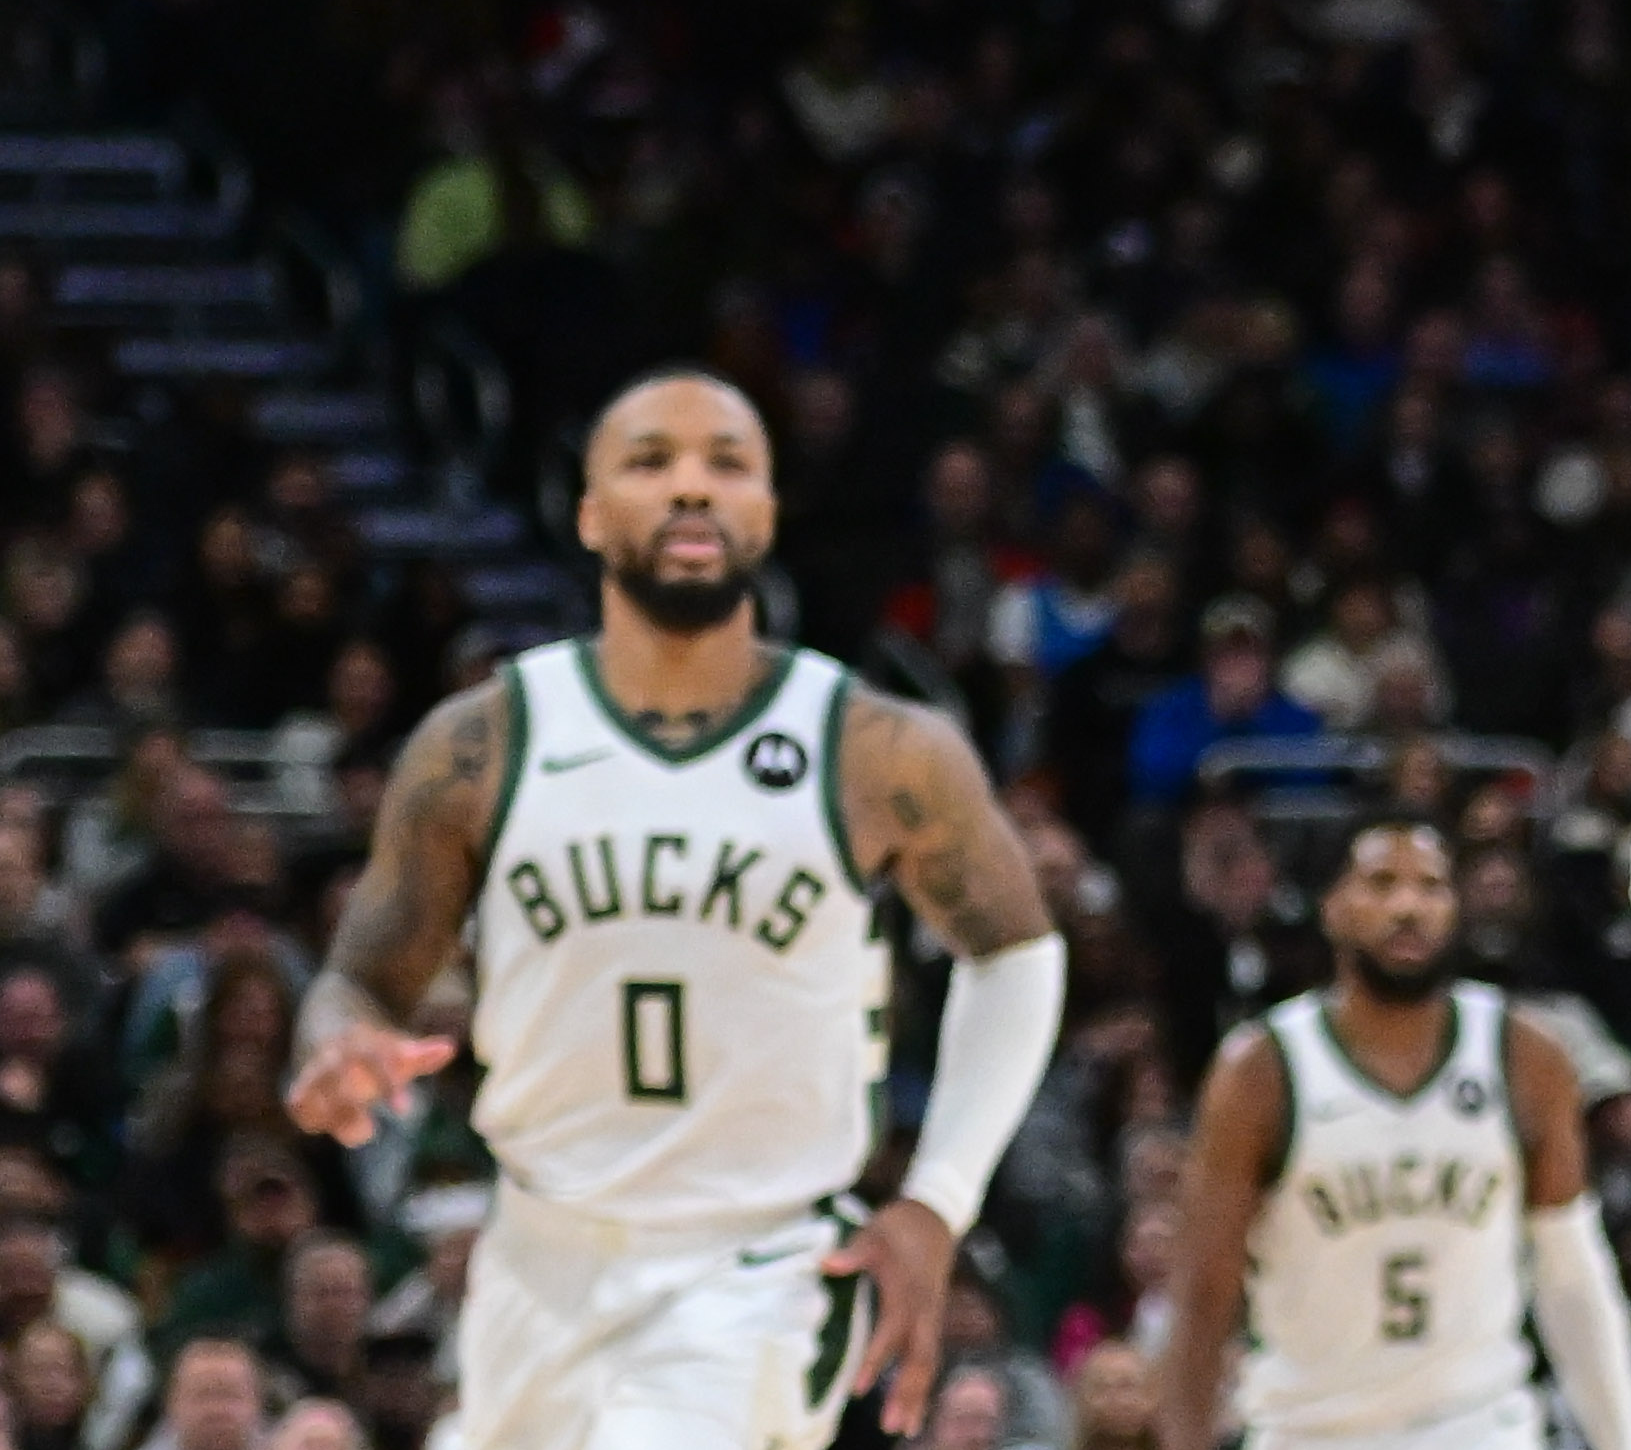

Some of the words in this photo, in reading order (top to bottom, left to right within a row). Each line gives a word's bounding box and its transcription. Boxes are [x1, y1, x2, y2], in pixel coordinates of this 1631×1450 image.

[506, 833, 824, 953] BUCKS
[620, 981, 688, 1104] 0
[1379, 1252, 1432, 1344] 5
